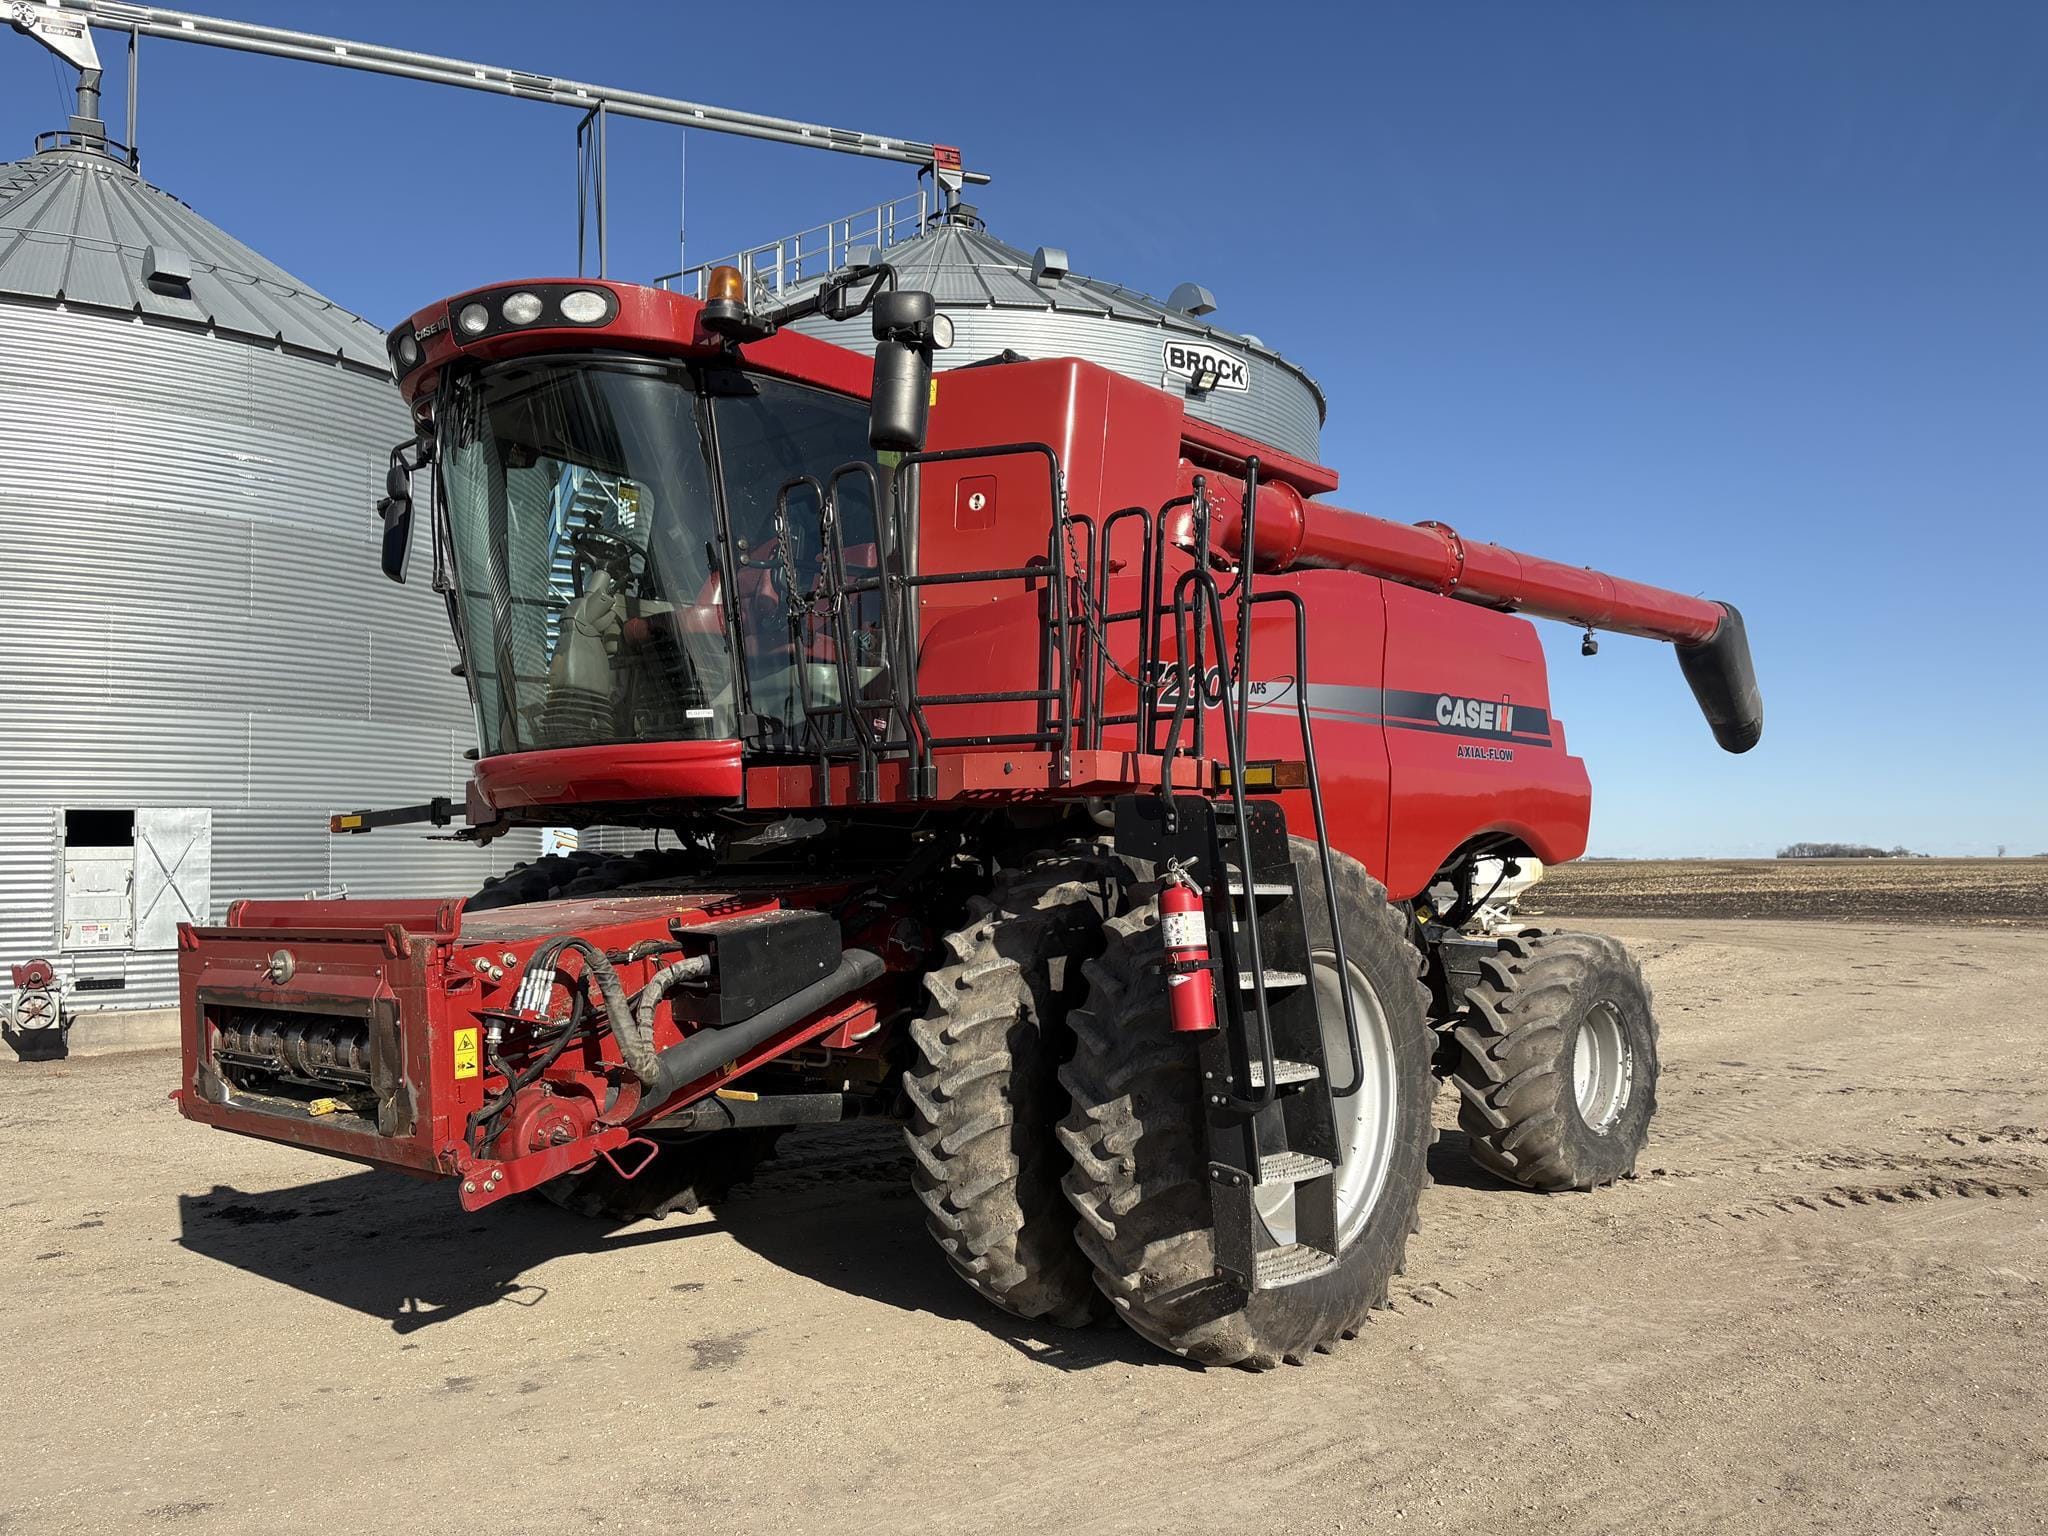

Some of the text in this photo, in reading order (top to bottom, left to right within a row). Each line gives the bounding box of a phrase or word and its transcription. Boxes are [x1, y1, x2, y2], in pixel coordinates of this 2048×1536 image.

[1169, 346, 1245, 385] BROCK
[1249, 681, 1267, 695] AFS
[1457, 745, 1513, 762] AXIAL-FLOW
